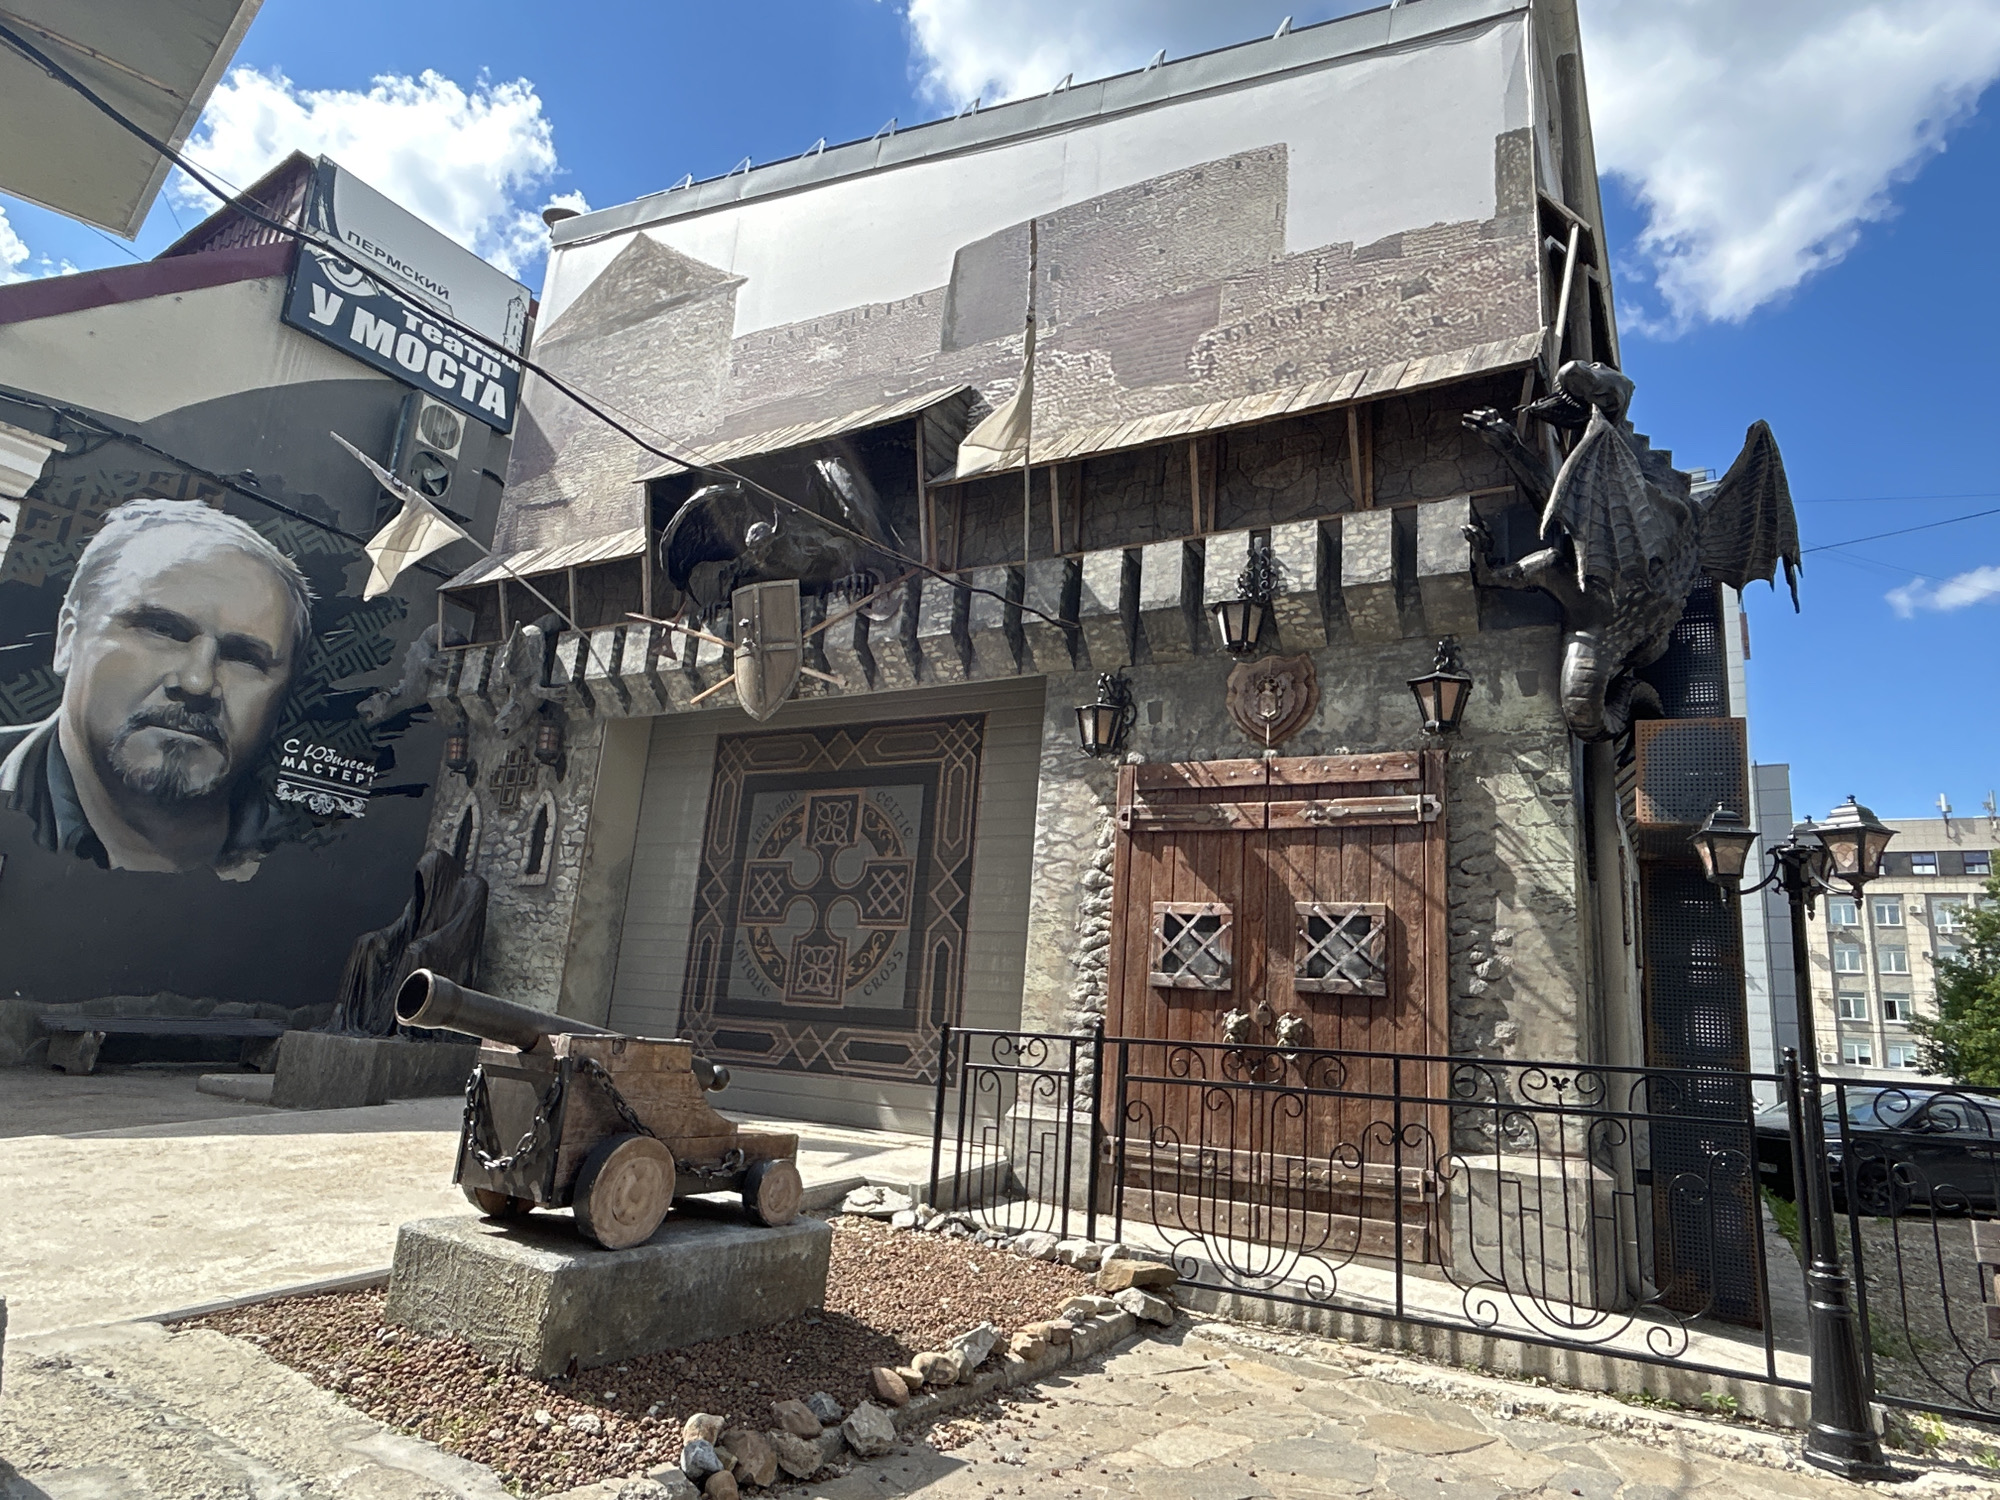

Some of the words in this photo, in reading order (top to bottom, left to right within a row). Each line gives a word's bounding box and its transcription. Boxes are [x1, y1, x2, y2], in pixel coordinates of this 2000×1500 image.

[348, 231, 451, 299] ПЕРМСКИЙ
[308, 282, 344, 326] У
[350, 306, 507, 420] МОСТА
[281, 756, 374, 786] МАСТЕР!
[284, 739, 300, 753] С
[304, 744, 379, 777] Юбилеем,
[864, 950, 904, 996] CROSS
